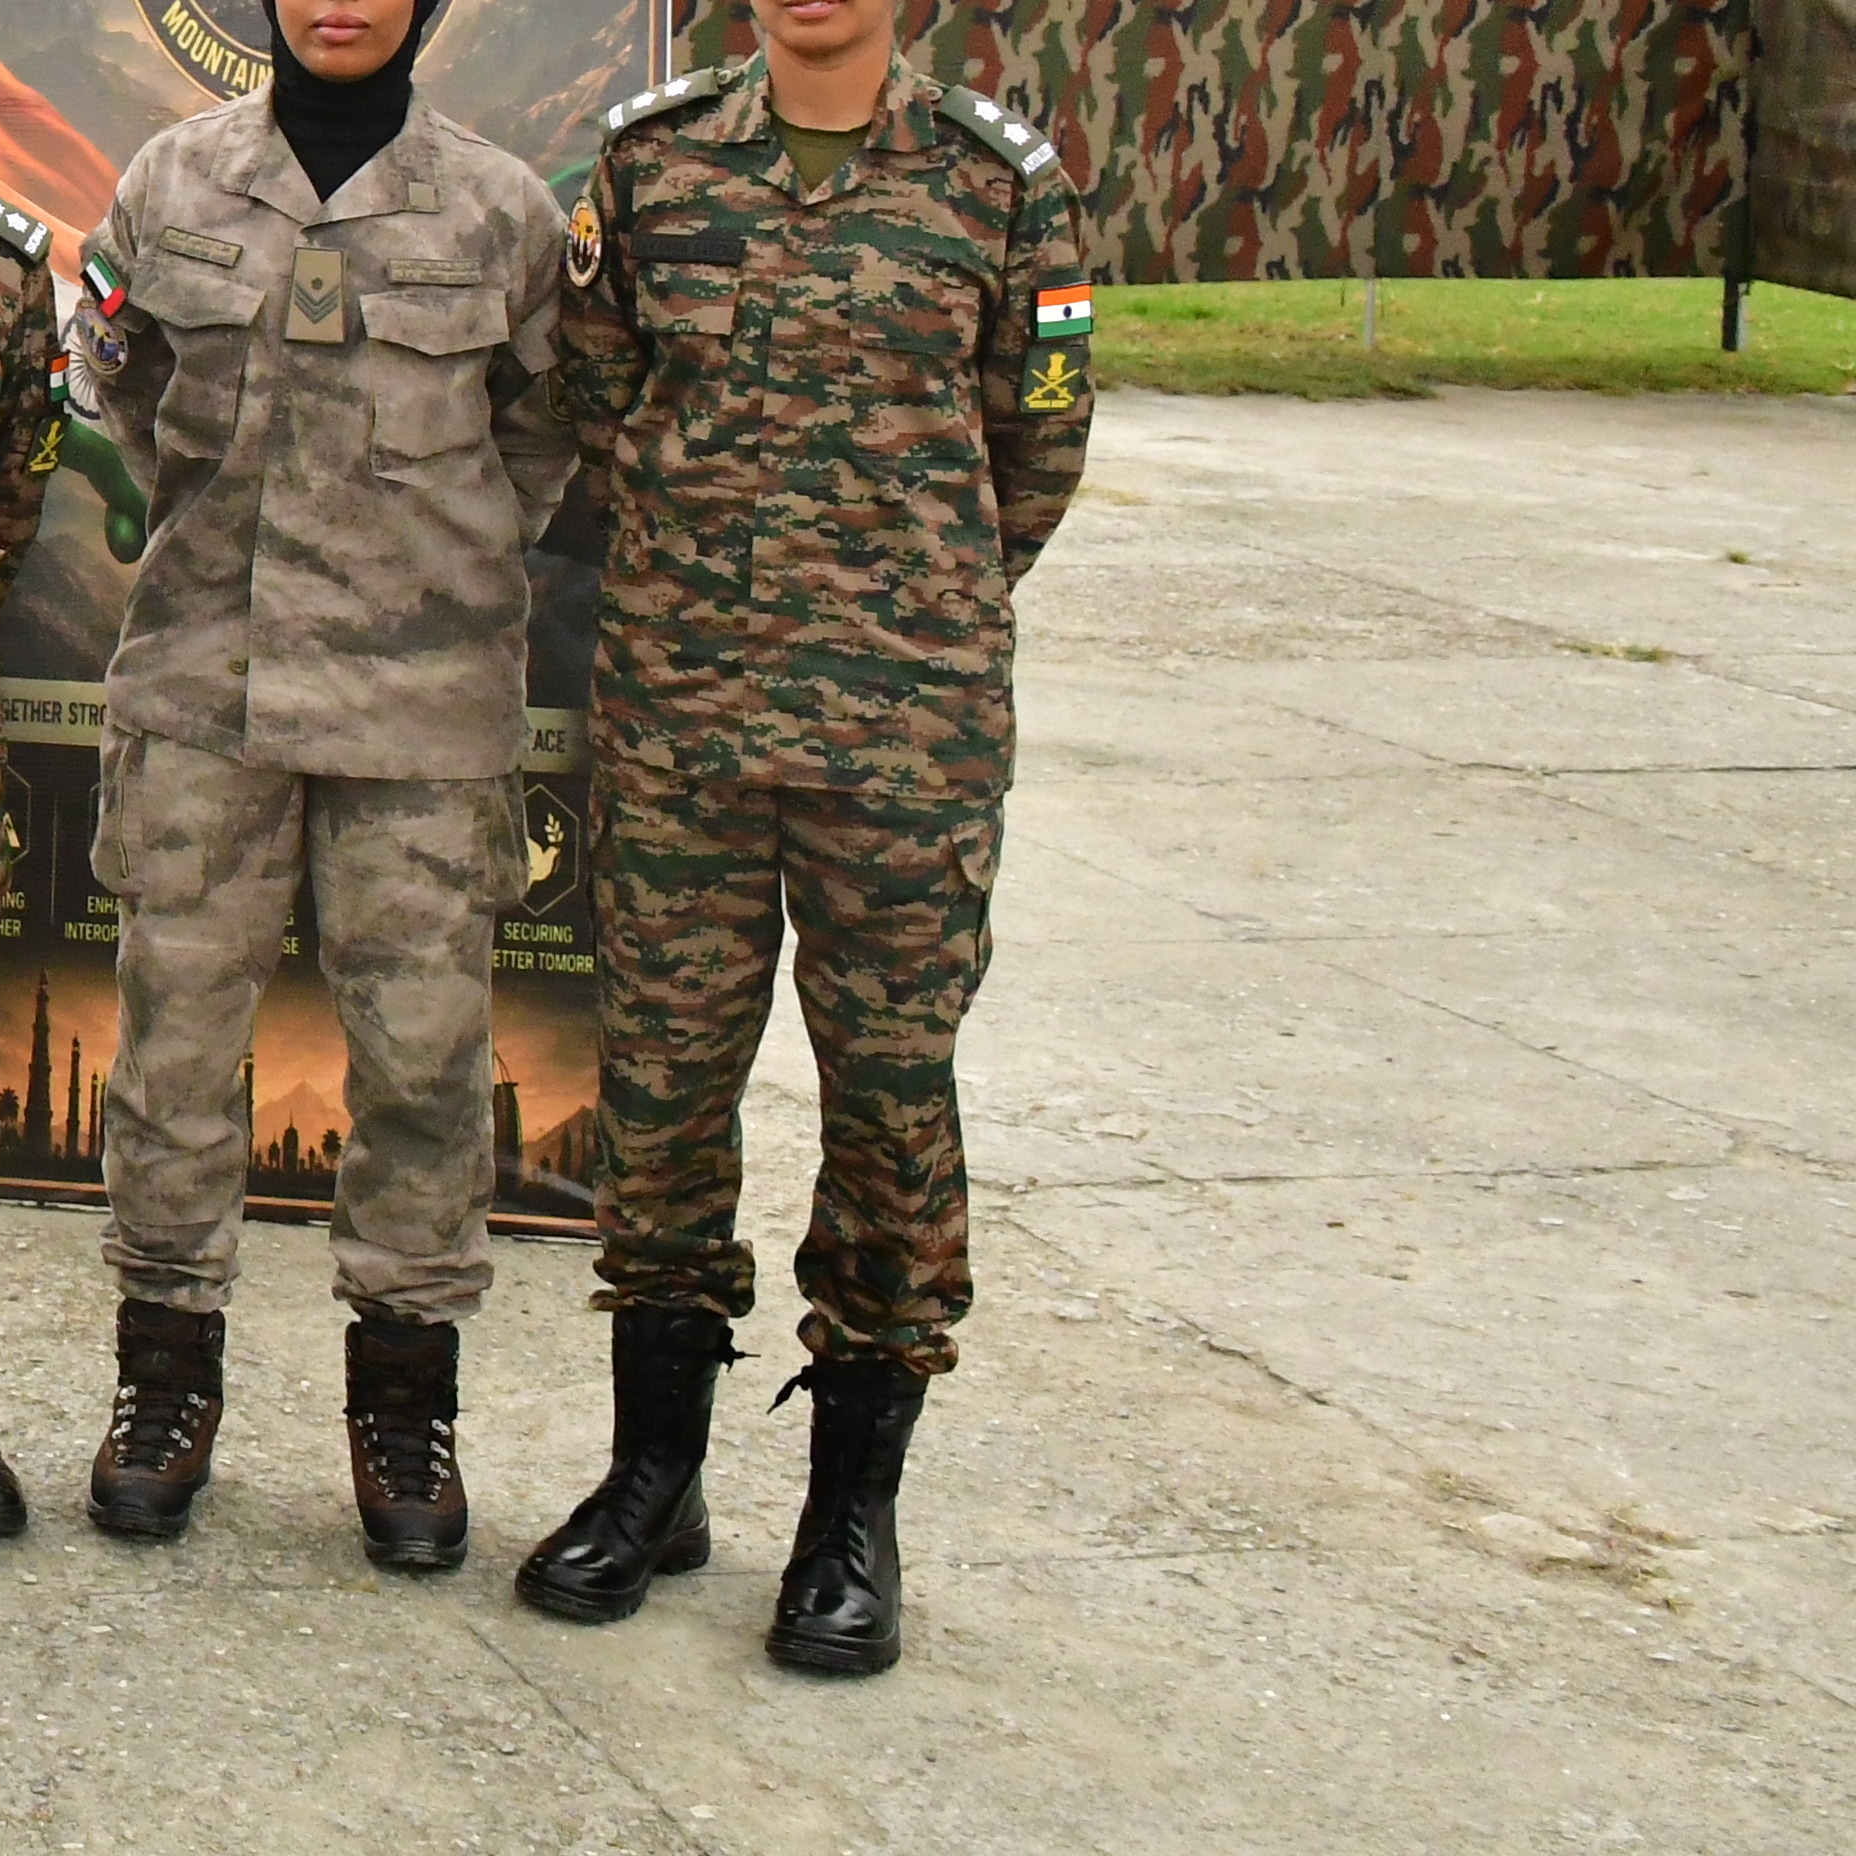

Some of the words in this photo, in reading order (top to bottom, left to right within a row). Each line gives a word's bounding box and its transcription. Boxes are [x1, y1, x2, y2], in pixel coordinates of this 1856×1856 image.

[531, 728, 566, 754] ACE
[86, 895, 121, 914] ENHA
[64, 921, 120, 943] INTEROP
[503, 921, 574, 944] SECURING
[491, 948, 535, 970] ETTER
[538, 951, 596, 974] TOMORR
